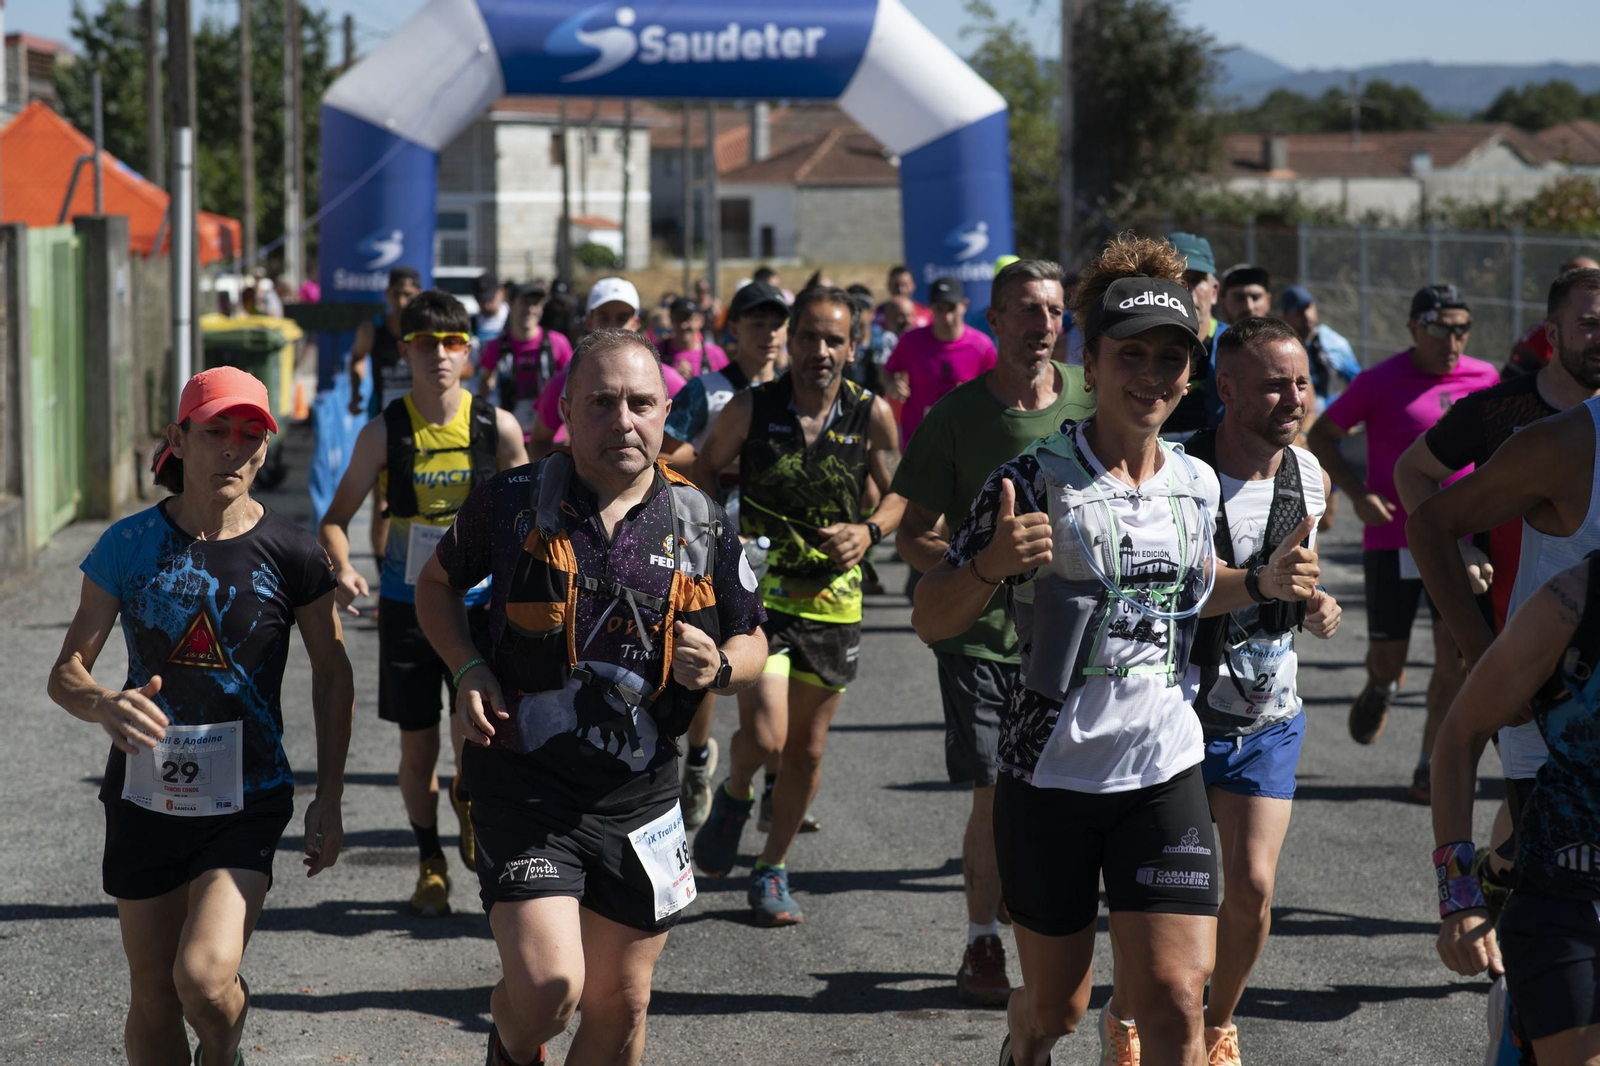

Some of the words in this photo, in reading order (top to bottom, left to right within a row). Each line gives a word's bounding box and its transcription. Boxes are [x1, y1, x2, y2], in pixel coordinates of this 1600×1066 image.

[638, 22, 827, 65] Saudeter
[333, 266, 390, 291] Saude
[923, 261, 994, 284] Saudete
[1119, 290, 1189, 318] adidas
[1142, 548, 1170, 558] EDICIÓN
[1252, 672, 1276, 692] 27
[173, 737, 181, 745] &
[183, 734, 223, 746] Andaina
[162, 760, 200, 784] 29
[656, 824, 673, 841] Trail
[1156, 877, 1209, 886] NOGUEIRA
[1157, 870, 1210, 880] CABALEIRO
